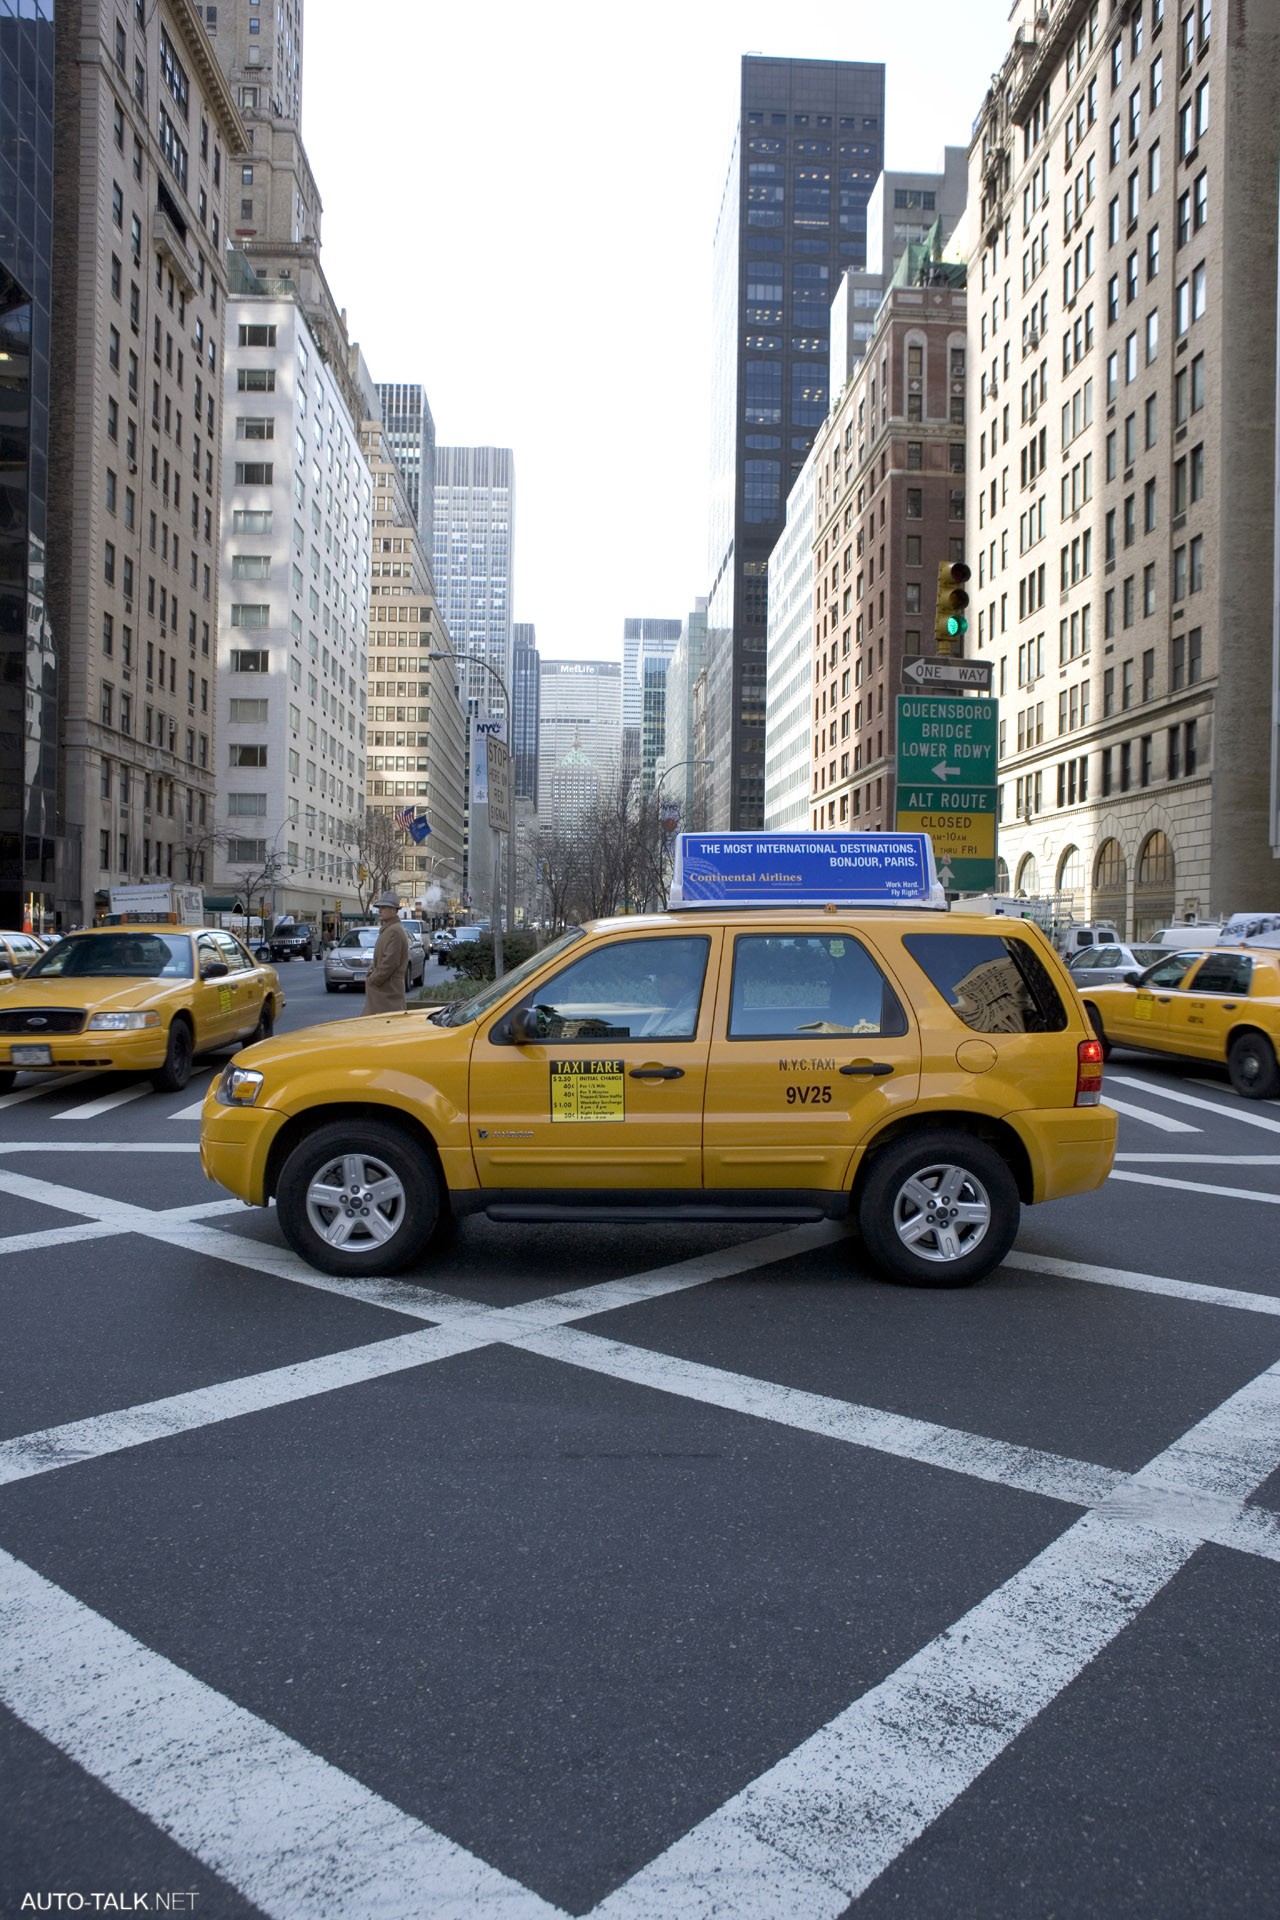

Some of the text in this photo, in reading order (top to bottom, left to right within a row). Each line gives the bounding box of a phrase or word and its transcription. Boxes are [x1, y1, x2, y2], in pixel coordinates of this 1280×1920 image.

[560, 664, 595, 673] MetLife
[915, 666, 985, 681] ONE WAY
[902, 703, 992, 720] QUEENSBORO
[476, 723, 501, 734] NYC
[921, 723, 973, 739] BRIDGE
[488, 742, 507, 769] STOP
[902, 743, 992, 759] LOWER RDWY
[494, 788, 504, 804] RED
[908, 793, 987, 809] ALT ROUTE
[490, 806, 509, 825] SIGNAL
[920, 816, 972, 829] CLOSED
[932, 832, 967, 841] AM-10AM
[700, 843, 917, 854] THE MOST INTERNATIONAL DESTINATIONS.
[961, 845, 977, 854] FRI
[829, 857, 918, 868] BONJOUR, PARIS.
[689, 872, 803, 883] Continental Airlines
[891, 888, 920, 897] Fly Right.
[556, 1061, 620, 1073] TAXI FARE
[786, 1086, 832, 1104] 9V25
